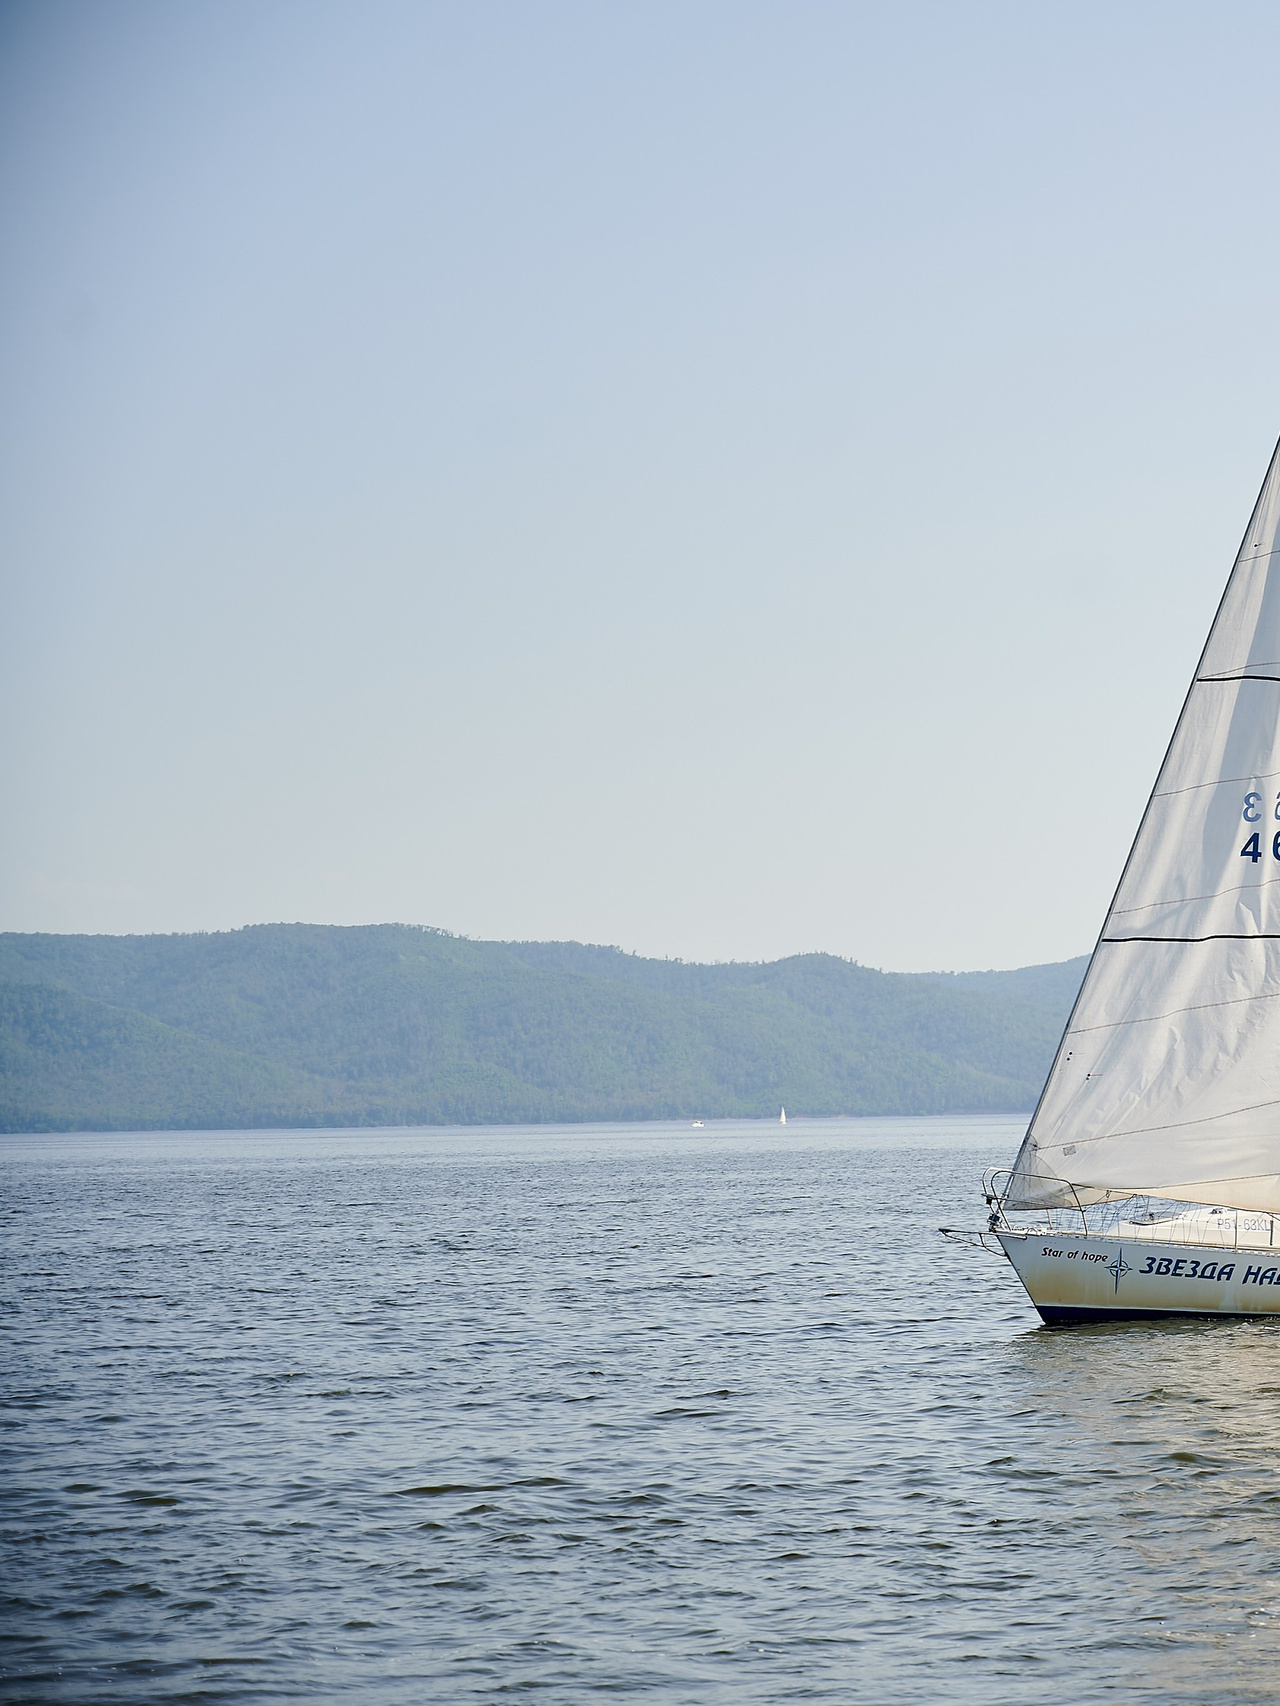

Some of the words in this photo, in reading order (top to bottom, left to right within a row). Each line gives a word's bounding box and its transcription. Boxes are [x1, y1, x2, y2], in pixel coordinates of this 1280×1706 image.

[1041, 1247, 1064, 1258] Star
[1067, 1250, 1079, 1260] of
[1081, 1251, 1108, 1264] hope
[1139, 1256, 1236, 1282] ЗВЕЗДА
